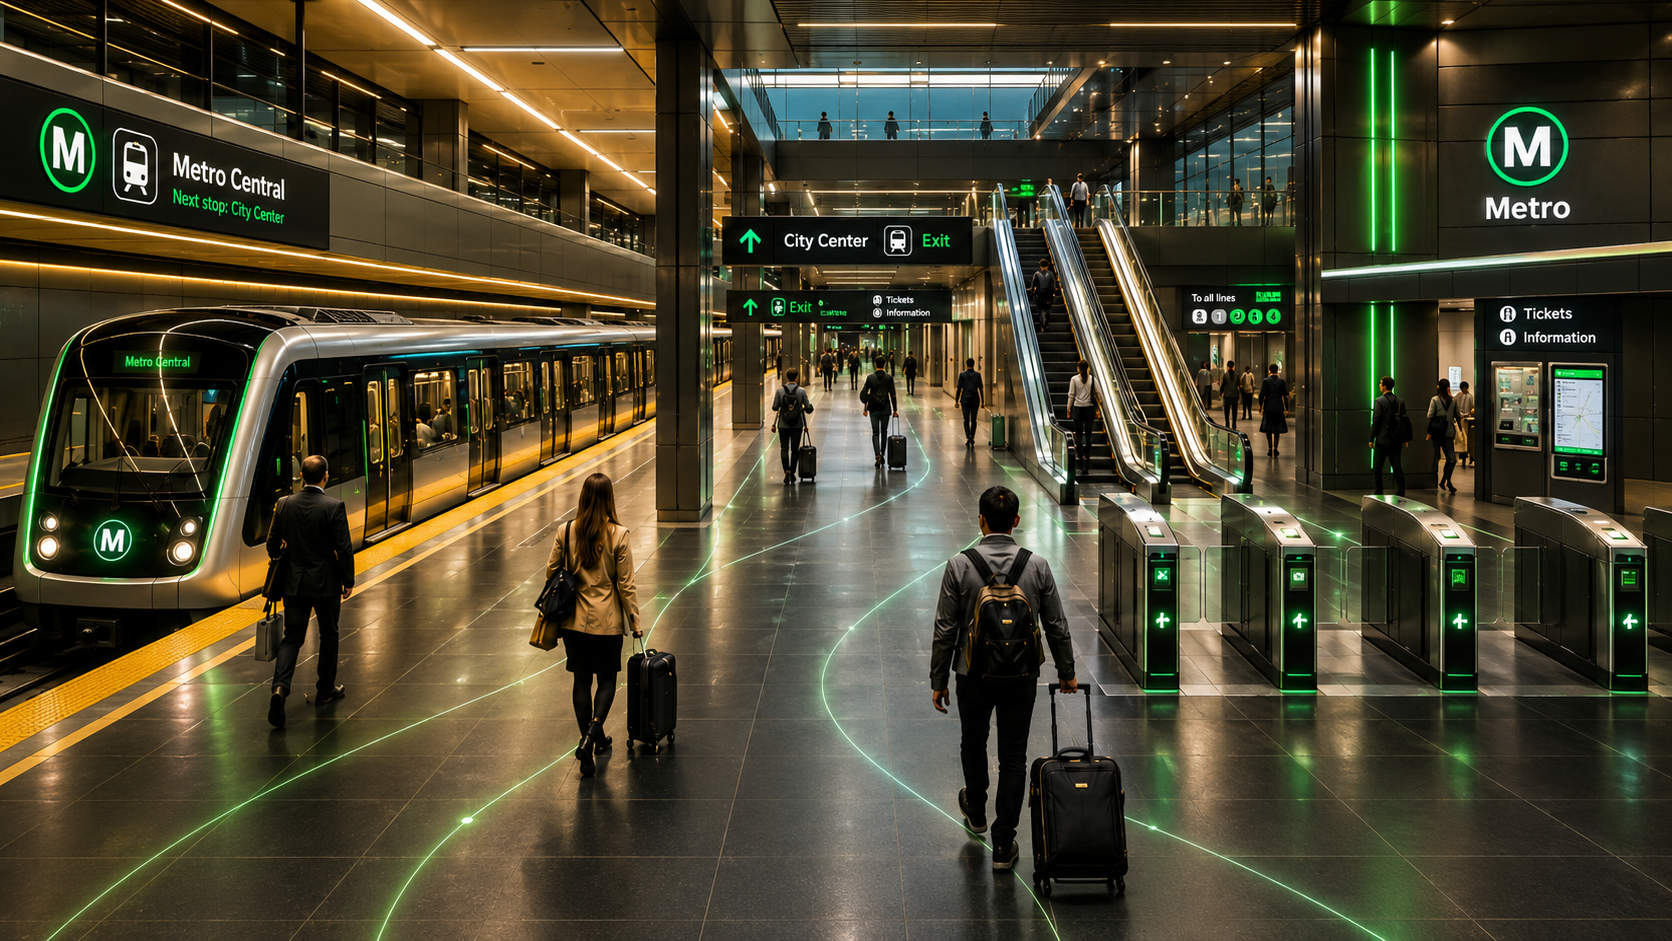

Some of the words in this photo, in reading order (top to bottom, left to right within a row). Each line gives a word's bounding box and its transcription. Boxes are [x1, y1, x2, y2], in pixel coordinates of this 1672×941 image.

[53, 125, 85, 174] M
[1504, 126, 1551, 167] M
[173, 152, 226, 188] Metro
[230, 168, 285, 201] Central
[172, 189, 199, 208] Next
[202, 196, 228, 215] stop:
[231, 201, 251, 222] City
[254, 206, 284, 224] Center
[1485, 196, 1571, 220] Metro
[784, 233, 814, 251] City
[818, 233, 868, 248] Center
[922, 233, 951, 248] Exit
[886, 295, 914, 304] Tickets
[1191, 293, 1203, 302] To
[1203, 293, 1214, 302] all
[1216, 293, 1236, 302] lines
[789, 301, 812, 313] Exit
[886, 308, 931, 317] Information
[1523, 307, 1573, 320] Tickets
[1523, 330, 1597, 344] Information
[125, 355, 153, 368] Metro
[156, 355, 191, 368] Central
[100, 529, 124, 553] M
